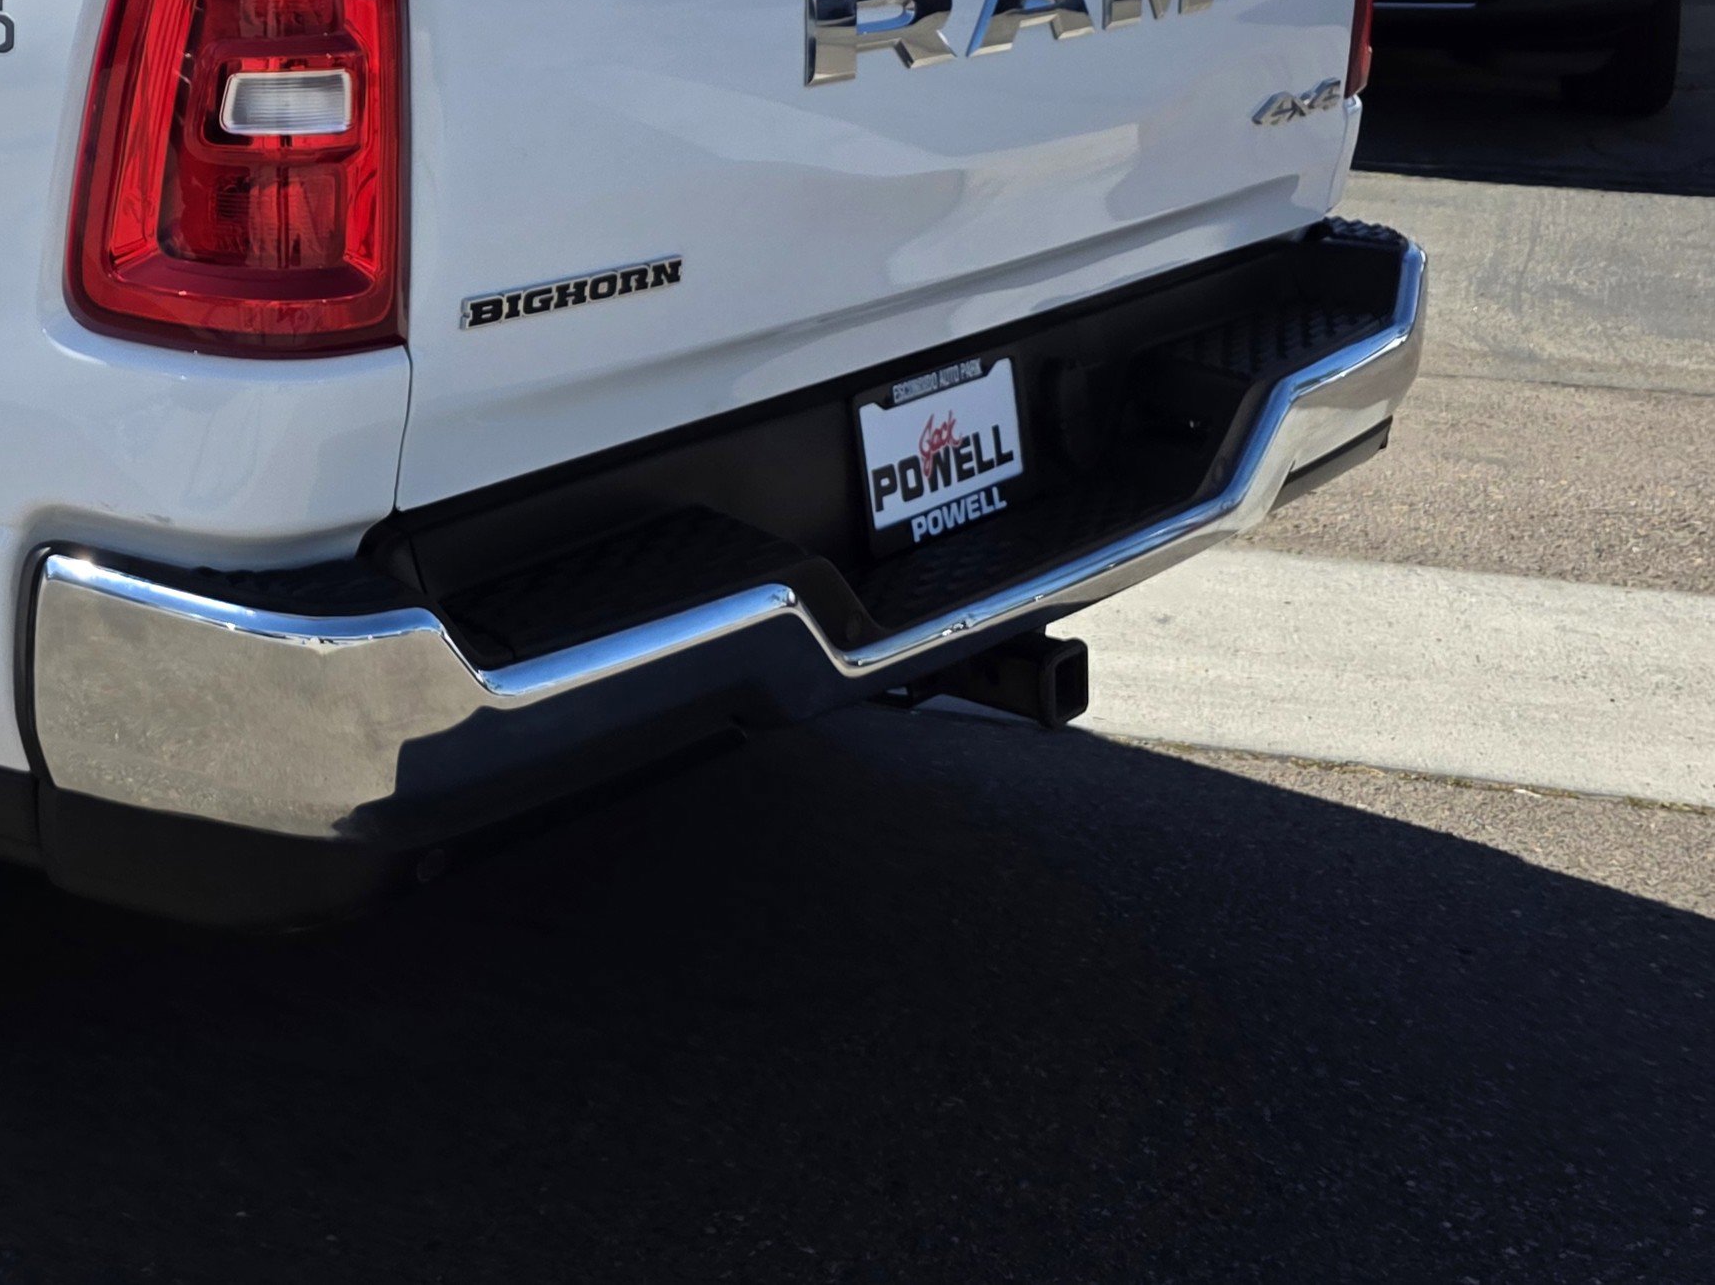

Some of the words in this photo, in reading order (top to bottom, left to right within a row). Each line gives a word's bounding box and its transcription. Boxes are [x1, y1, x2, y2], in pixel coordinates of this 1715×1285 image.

[460, 254, 683, 330] BIGHORN
[872, 425, 1014, 513] POWELL
[911, 486, 1007, 543] POWELL
